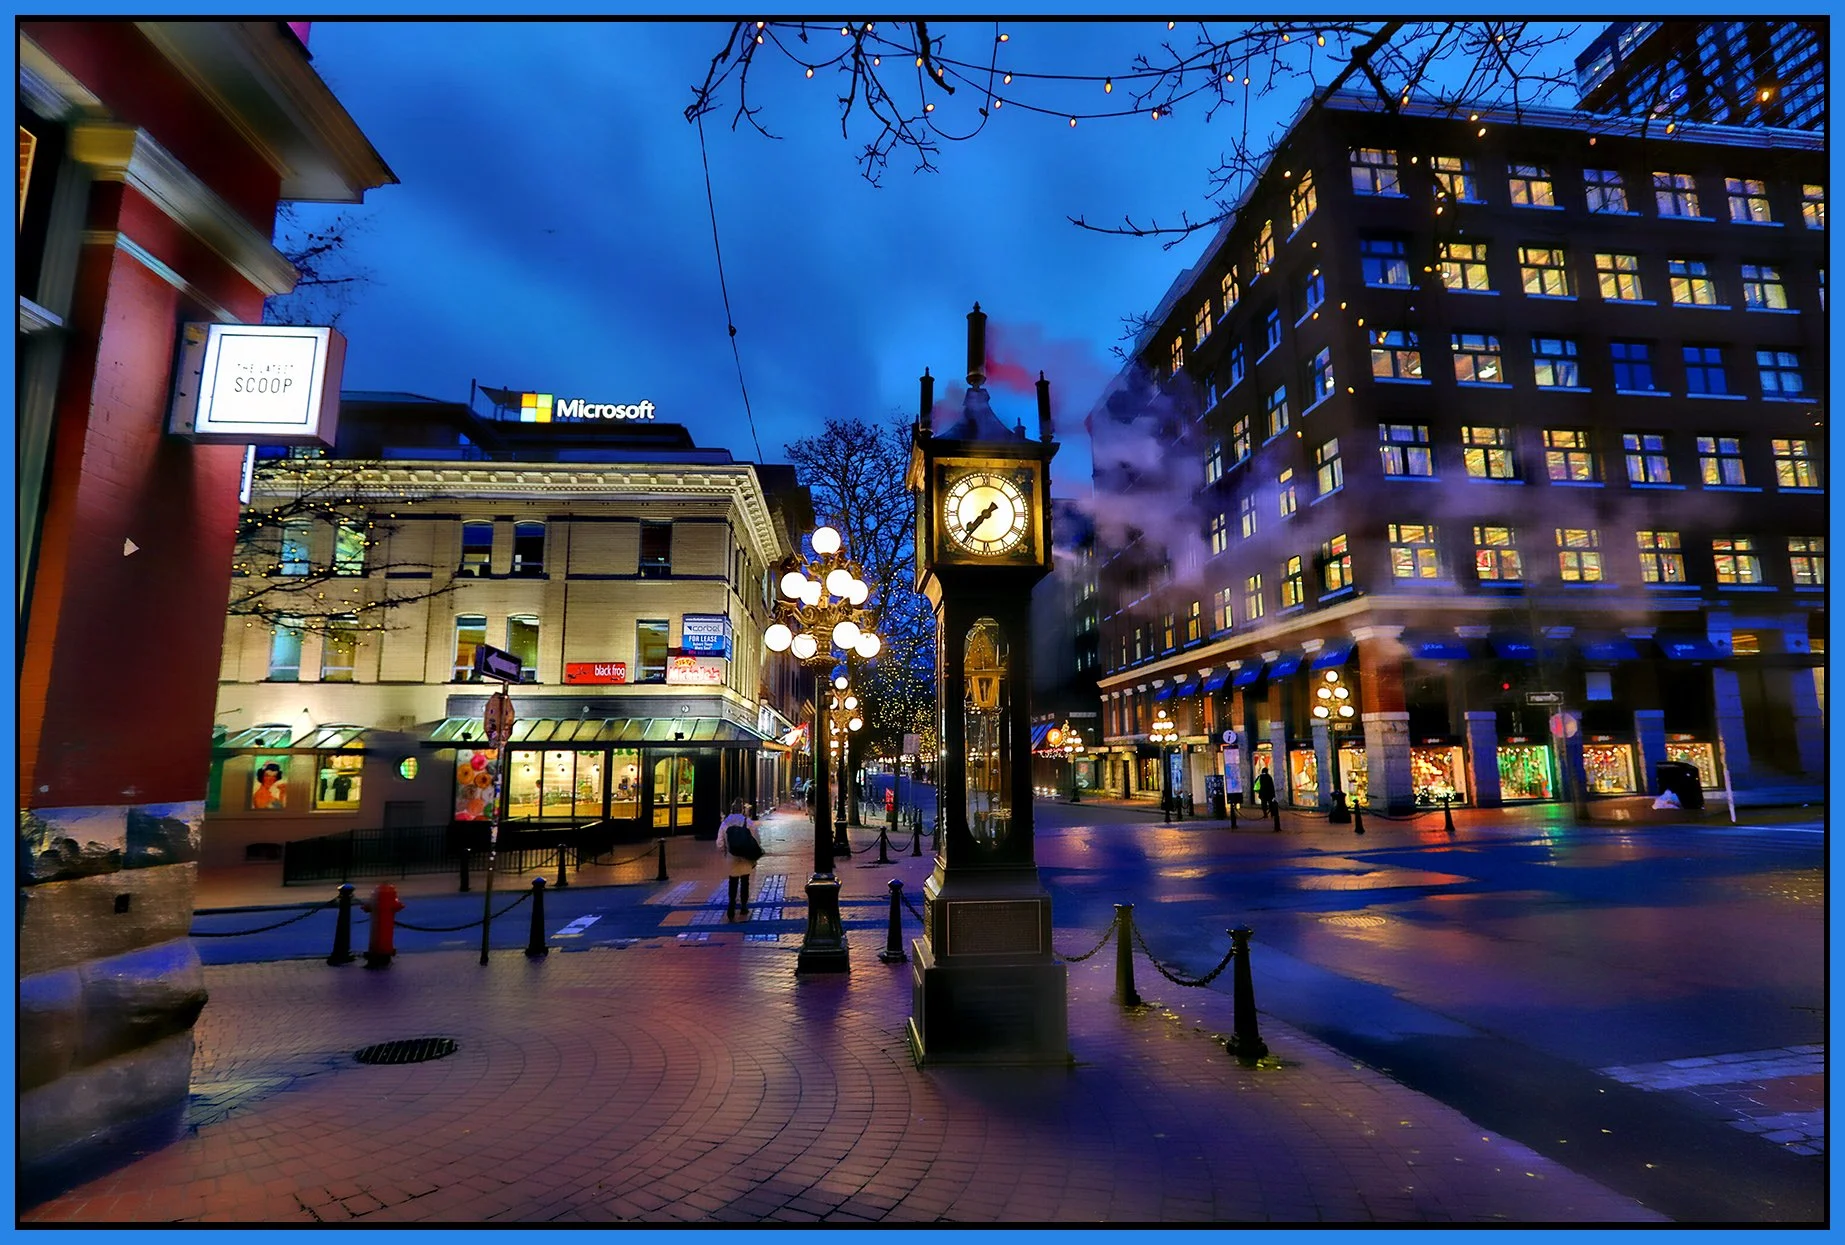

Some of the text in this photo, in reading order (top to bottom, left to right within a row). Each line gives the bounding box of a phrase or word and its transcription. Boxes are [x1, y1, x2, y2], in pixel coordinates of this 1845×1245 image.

[234, 376, 293, 394] SCOOP
[556, 399, 655, 419] Microsoft
[692, 624, 720, 632] corbel
[688, 635, 718, 643] FOR LEASE
[594, 664, 625, 679] black frog
